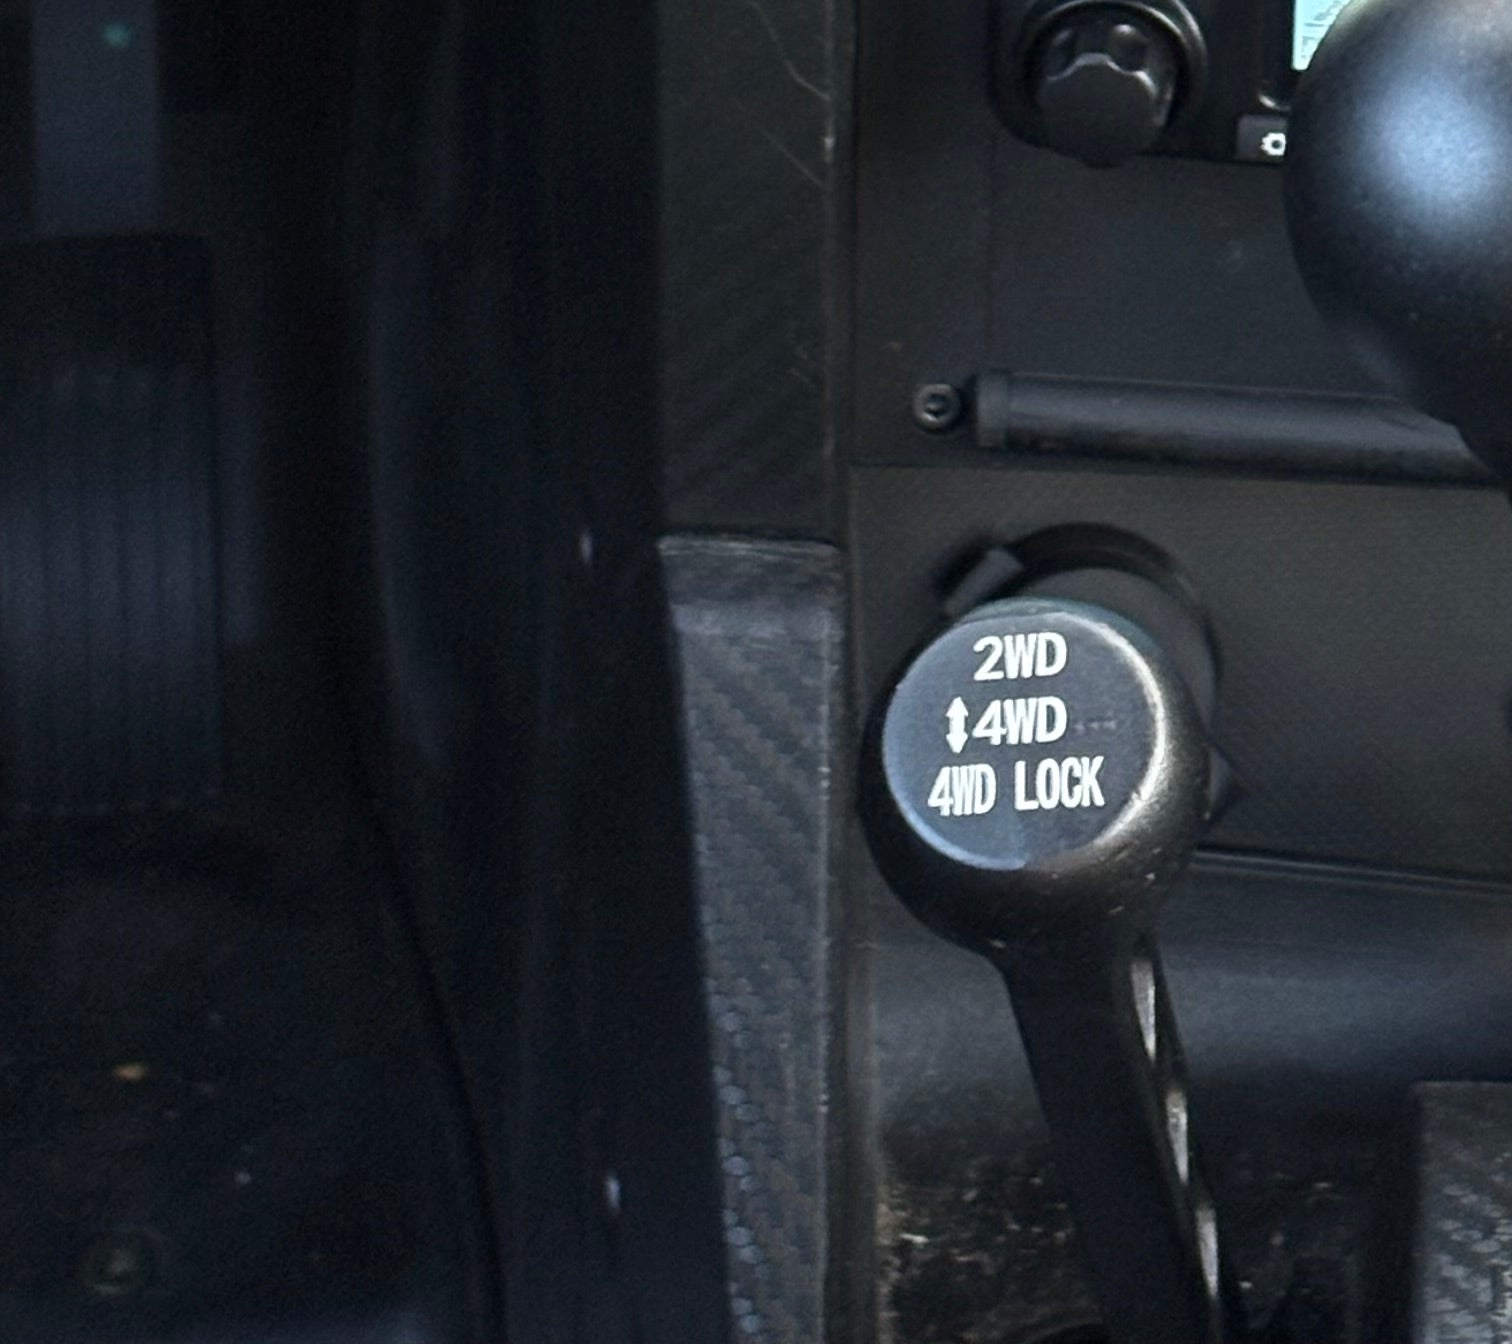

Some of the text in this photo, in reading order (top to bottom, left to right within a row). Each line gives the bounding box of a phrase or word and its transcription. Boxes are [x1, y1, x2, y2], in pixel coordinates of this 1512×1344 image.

[973, 632, 1068, 681] 2WD
[972, 696, 1068, 745] 4WD
[928, 756, 1105, 816] 4WD LOCK
